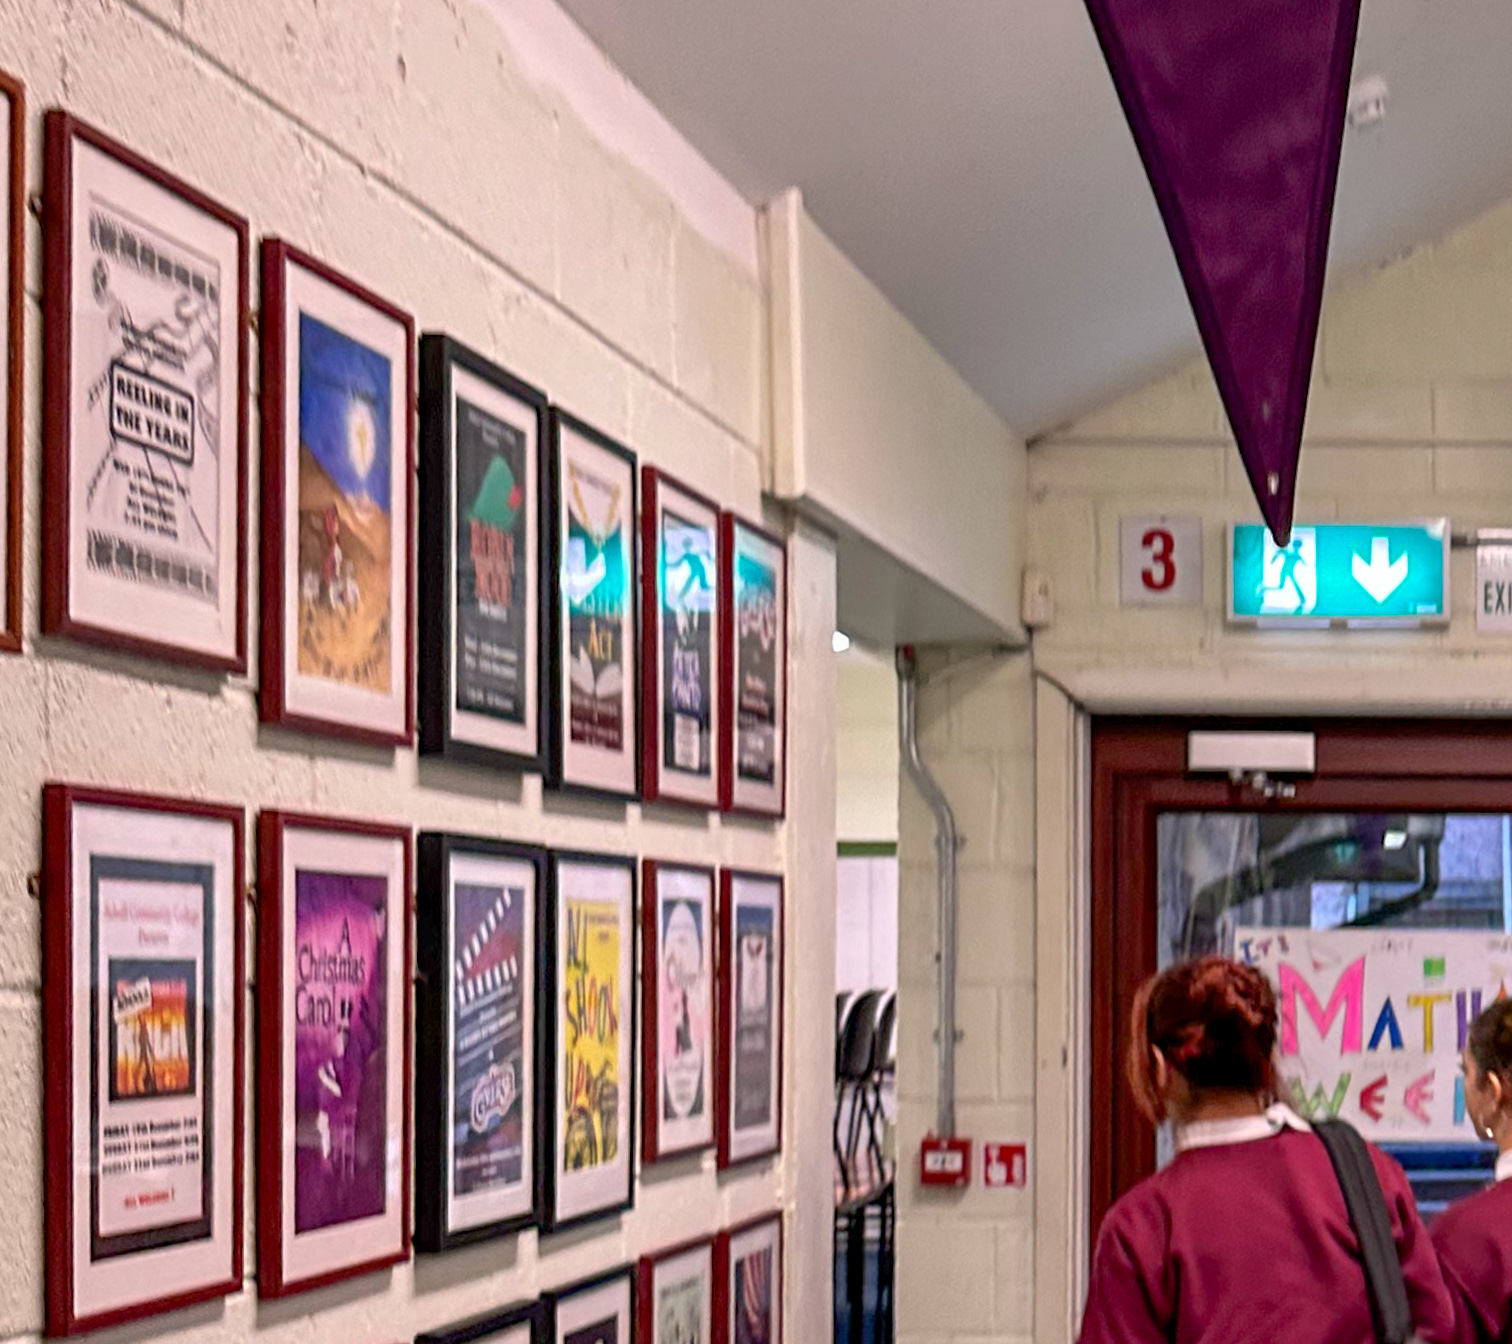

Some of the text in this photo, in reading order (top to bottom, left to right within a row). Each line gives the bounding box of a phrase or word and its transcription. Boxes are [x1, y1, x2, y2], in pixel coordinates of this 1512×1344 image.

[116, 374, 190, 424] REELING IN
[116, 405, 190, 451] THE YEARS
[1140, 527, 1177, 592] 3
[338, 916, 352, 955] A
[298, 943, 365, 985] Christmas
[296, 982, 336, 1028] Carol
[1278, 954, 1482, 1056] MATH
